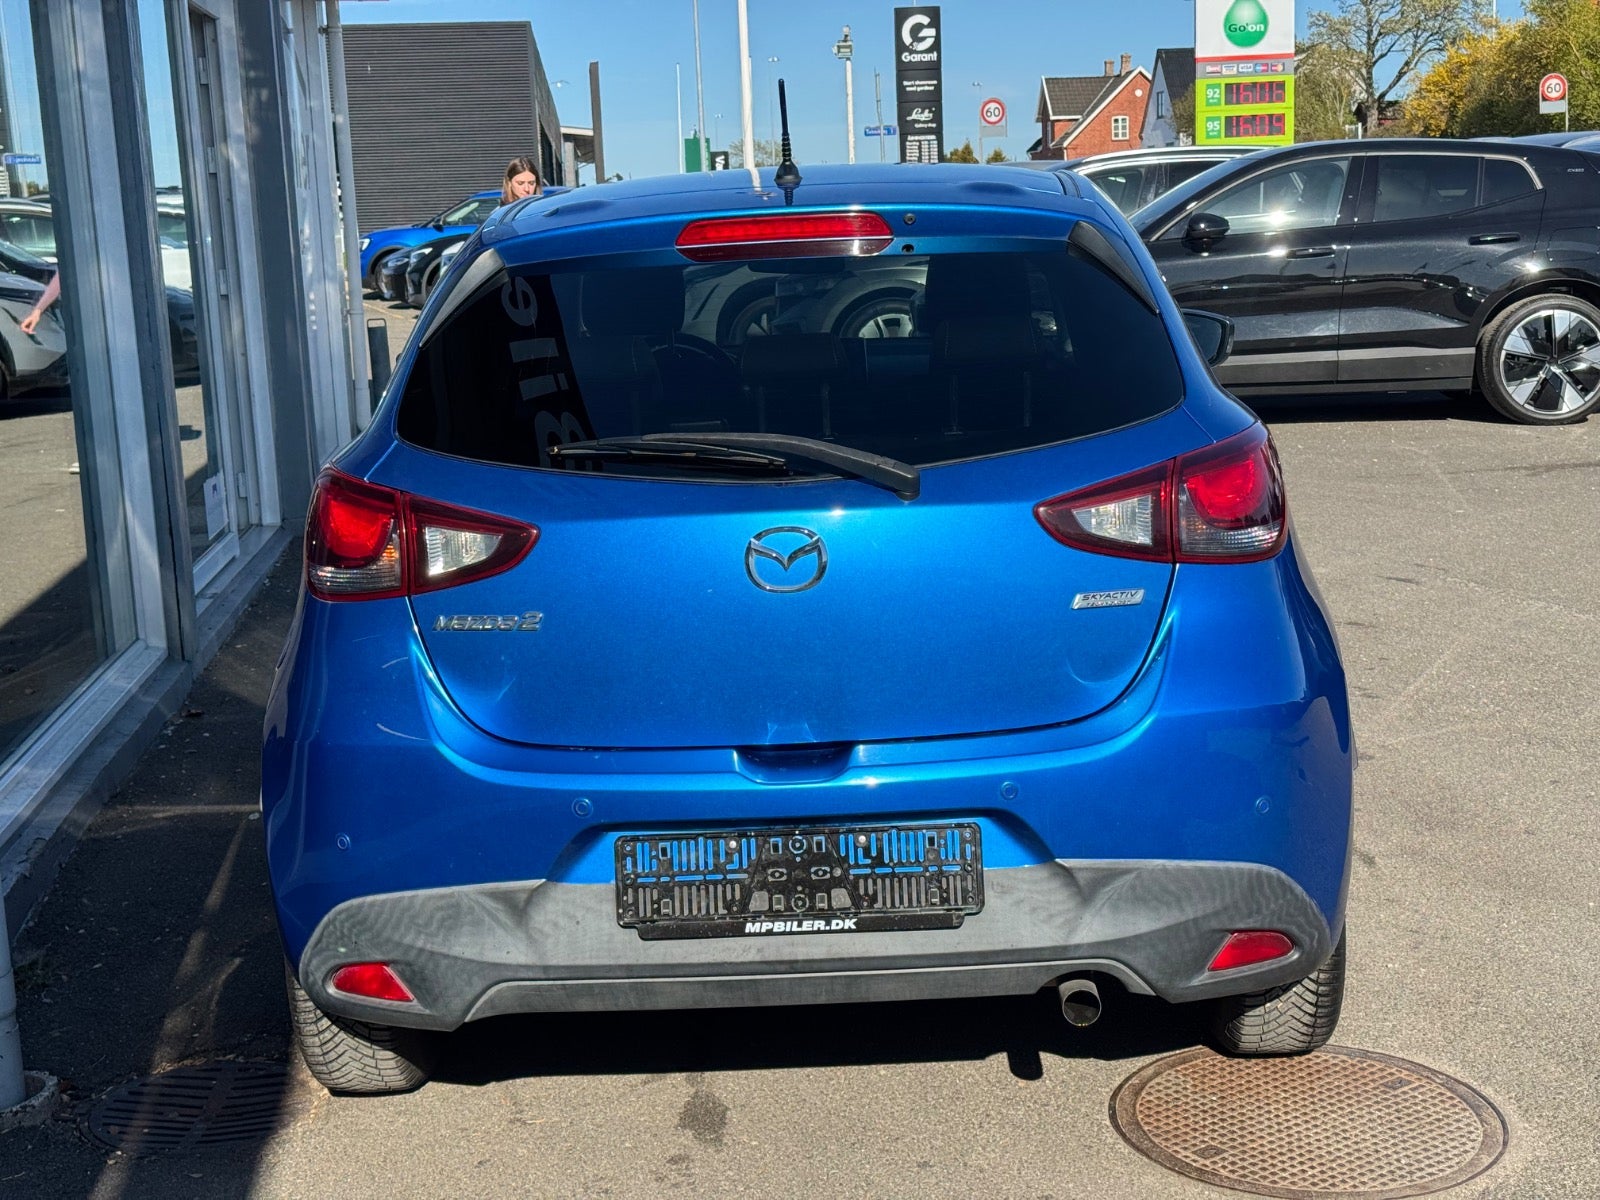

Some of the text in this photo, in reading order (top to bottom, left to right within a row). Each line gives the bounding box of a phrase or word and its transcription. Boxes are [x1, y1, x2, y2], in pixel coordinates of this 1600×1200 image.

[901, 51, 937, 62] Garant
[1207, 88, 1220, 98] 92
[1546, 83, 1561, 93] 60
[985, 106, 1001, 118] 60
[1207, 121, 1220, 131] 95
[1081, 590, 1138, 601] SKYACTIV
[744, 918, 858, 934] MPBILER.DK
